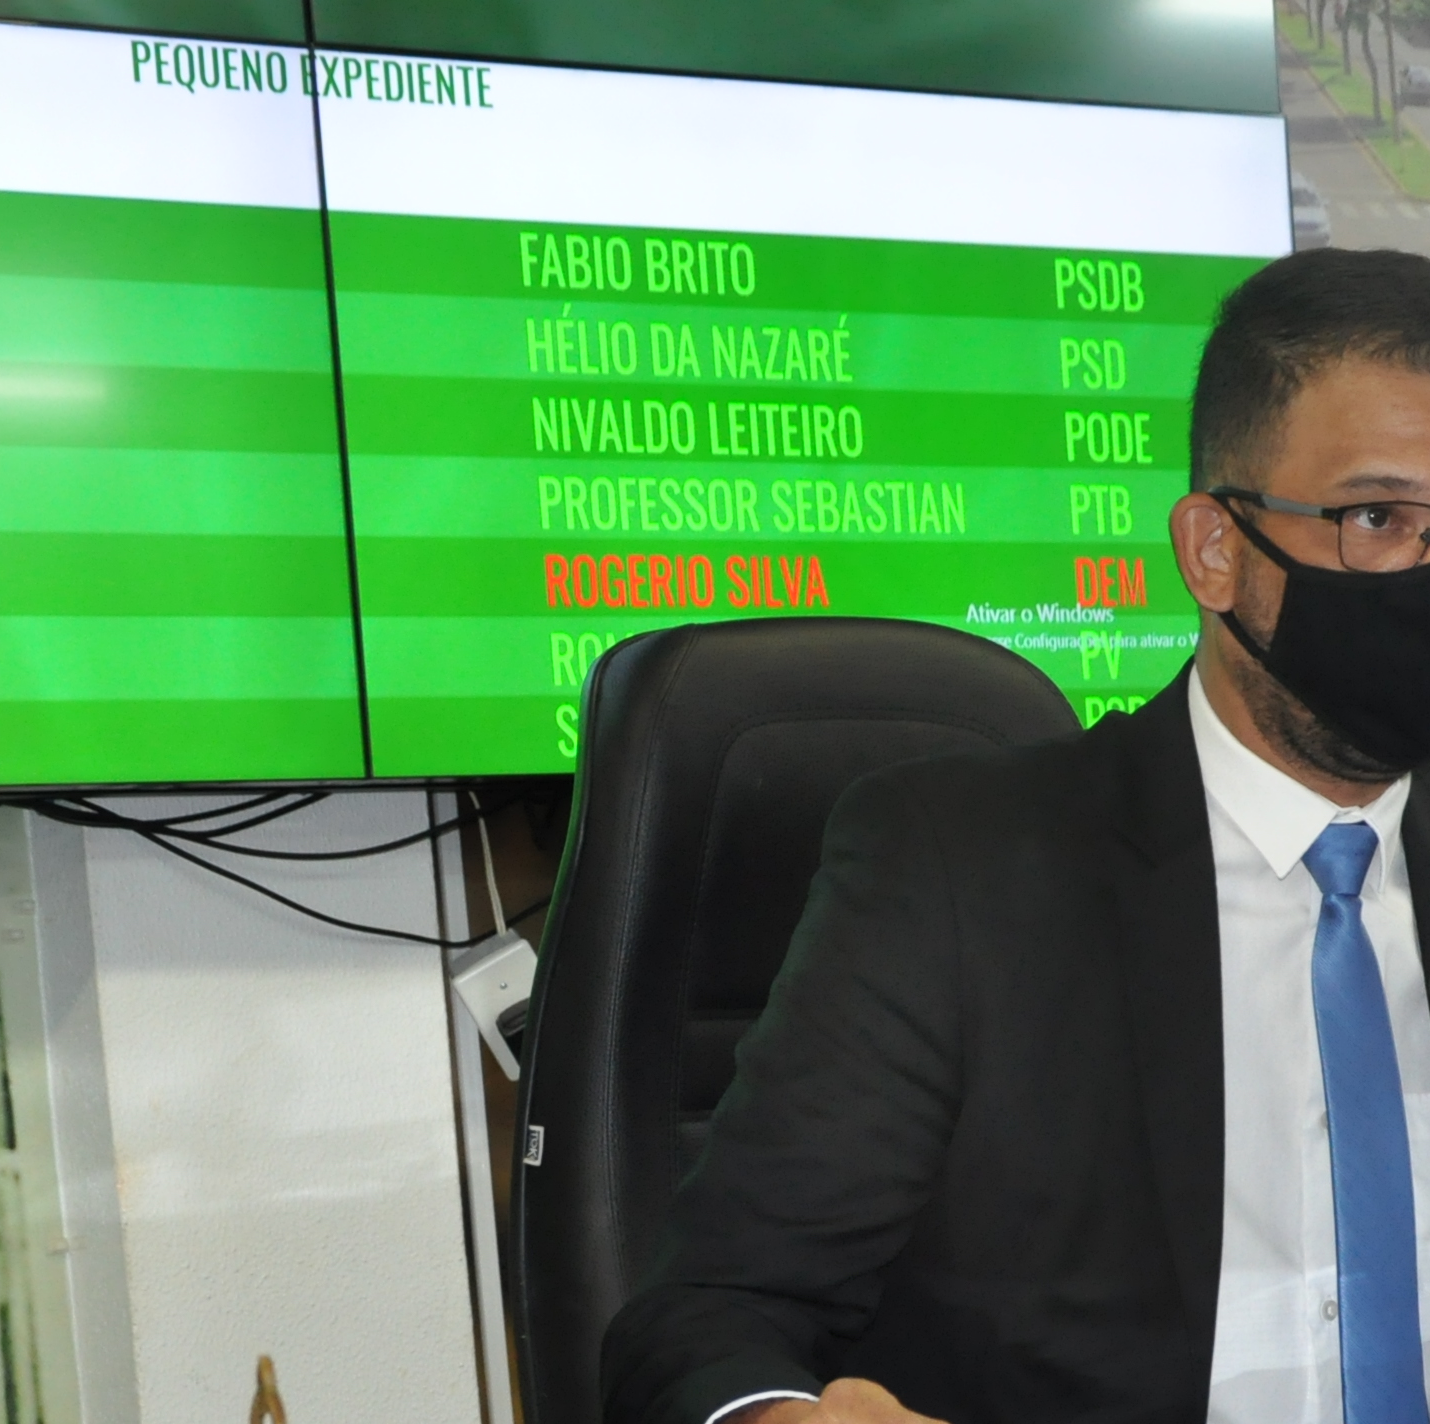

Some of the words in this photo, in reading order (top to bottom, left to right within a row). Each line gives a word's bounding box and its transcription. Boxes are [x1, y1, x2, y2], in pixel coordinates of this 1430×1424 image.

[130, 39, 288, 94] PEQUENO
[300, 53, 494, 109] EXPEDIENTE
[519, 231, 632, 292] FABIO
[644, 238, 757, 297] BRITO
[1054, 258, 1145, 313] PSDB
[526, 304, 638, 377] HÉLIO
[651, 321, 701, 378] DA
[712, 314, 853, 383] NAZARÉ
[1060, 339, 1126, 391] PSD
[531, 397, 695, 456] NIVALDO
[707, 403, 864, 459] LEITEIRO
[1064, 411, 1153, 465] PODE
[537, 475, 760, 532] PROFESSOR
[772, 479, 966, 534] SEBASTIAN
[1069, 484, 1133, 536] PTB
[544, 553, 714, 609] ROGERIO
[726, 556, 830, 608] SILVA
[1074, 558, 1147, 609] DEM
[966, 602, 1016, 623] Ativar
[1021, 608, 1033, 623] o
[1036, 603, 1114, 624] Windows
[1140, 632, 1174, 648] ativar
[1177, 636, 1187, 647] o
[1080, 630, 1122, 680] PV
